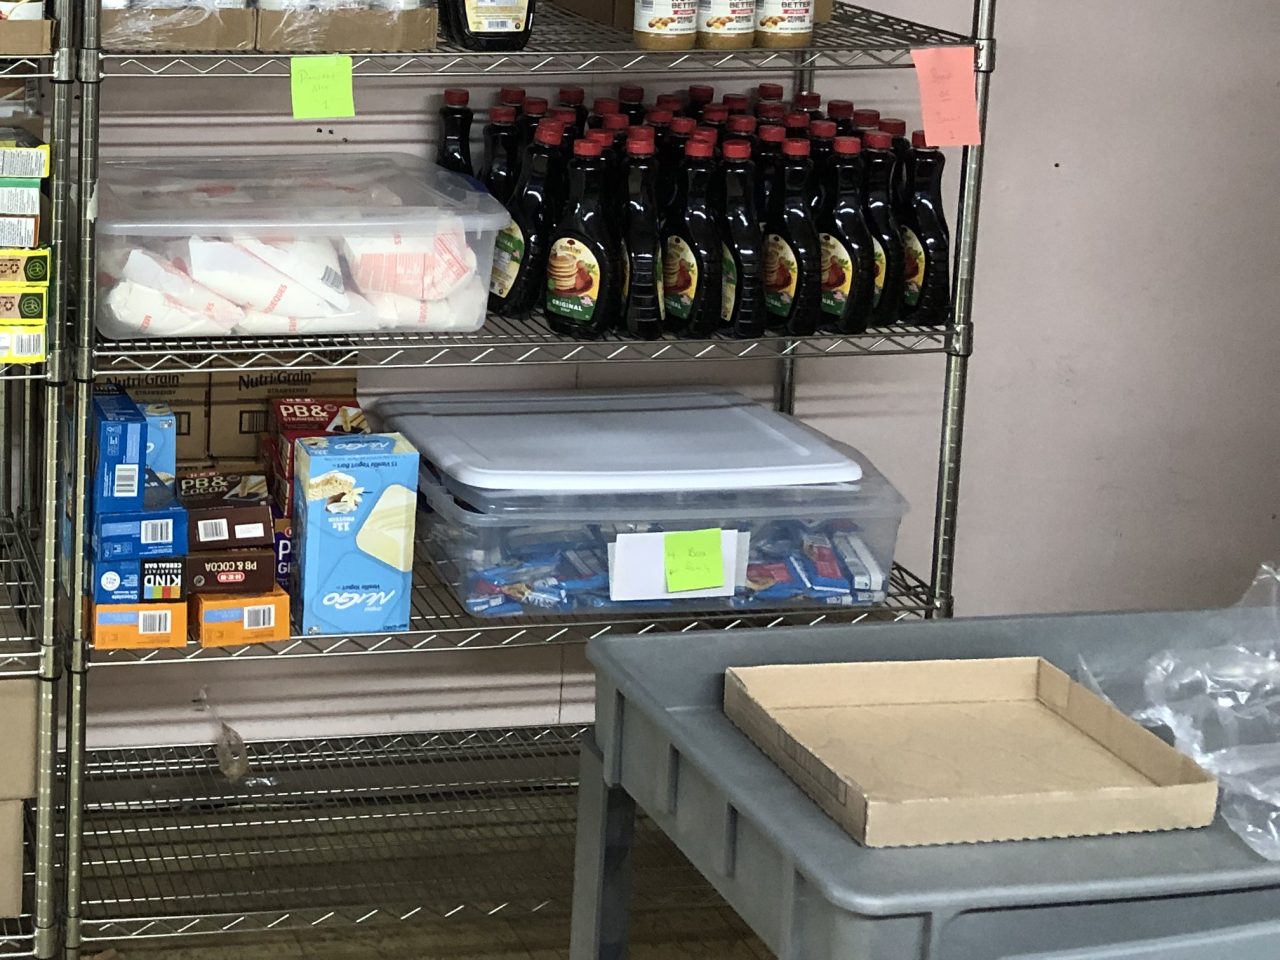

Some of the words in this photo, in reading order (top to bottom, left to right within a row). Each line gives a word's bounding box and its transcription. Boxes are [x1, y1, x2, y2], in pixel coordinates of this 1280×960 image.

[551, 298, 583, 312] ORIGINAL
[181, 478, 209, 490] PB
[181, 486, 228, 496] COCOA
[205, 561, 235, 572] COCOA
[237, 561, 245, 570] &
[245, 561, 257, 570] PB
[144, 574, 182, 587] KIND
